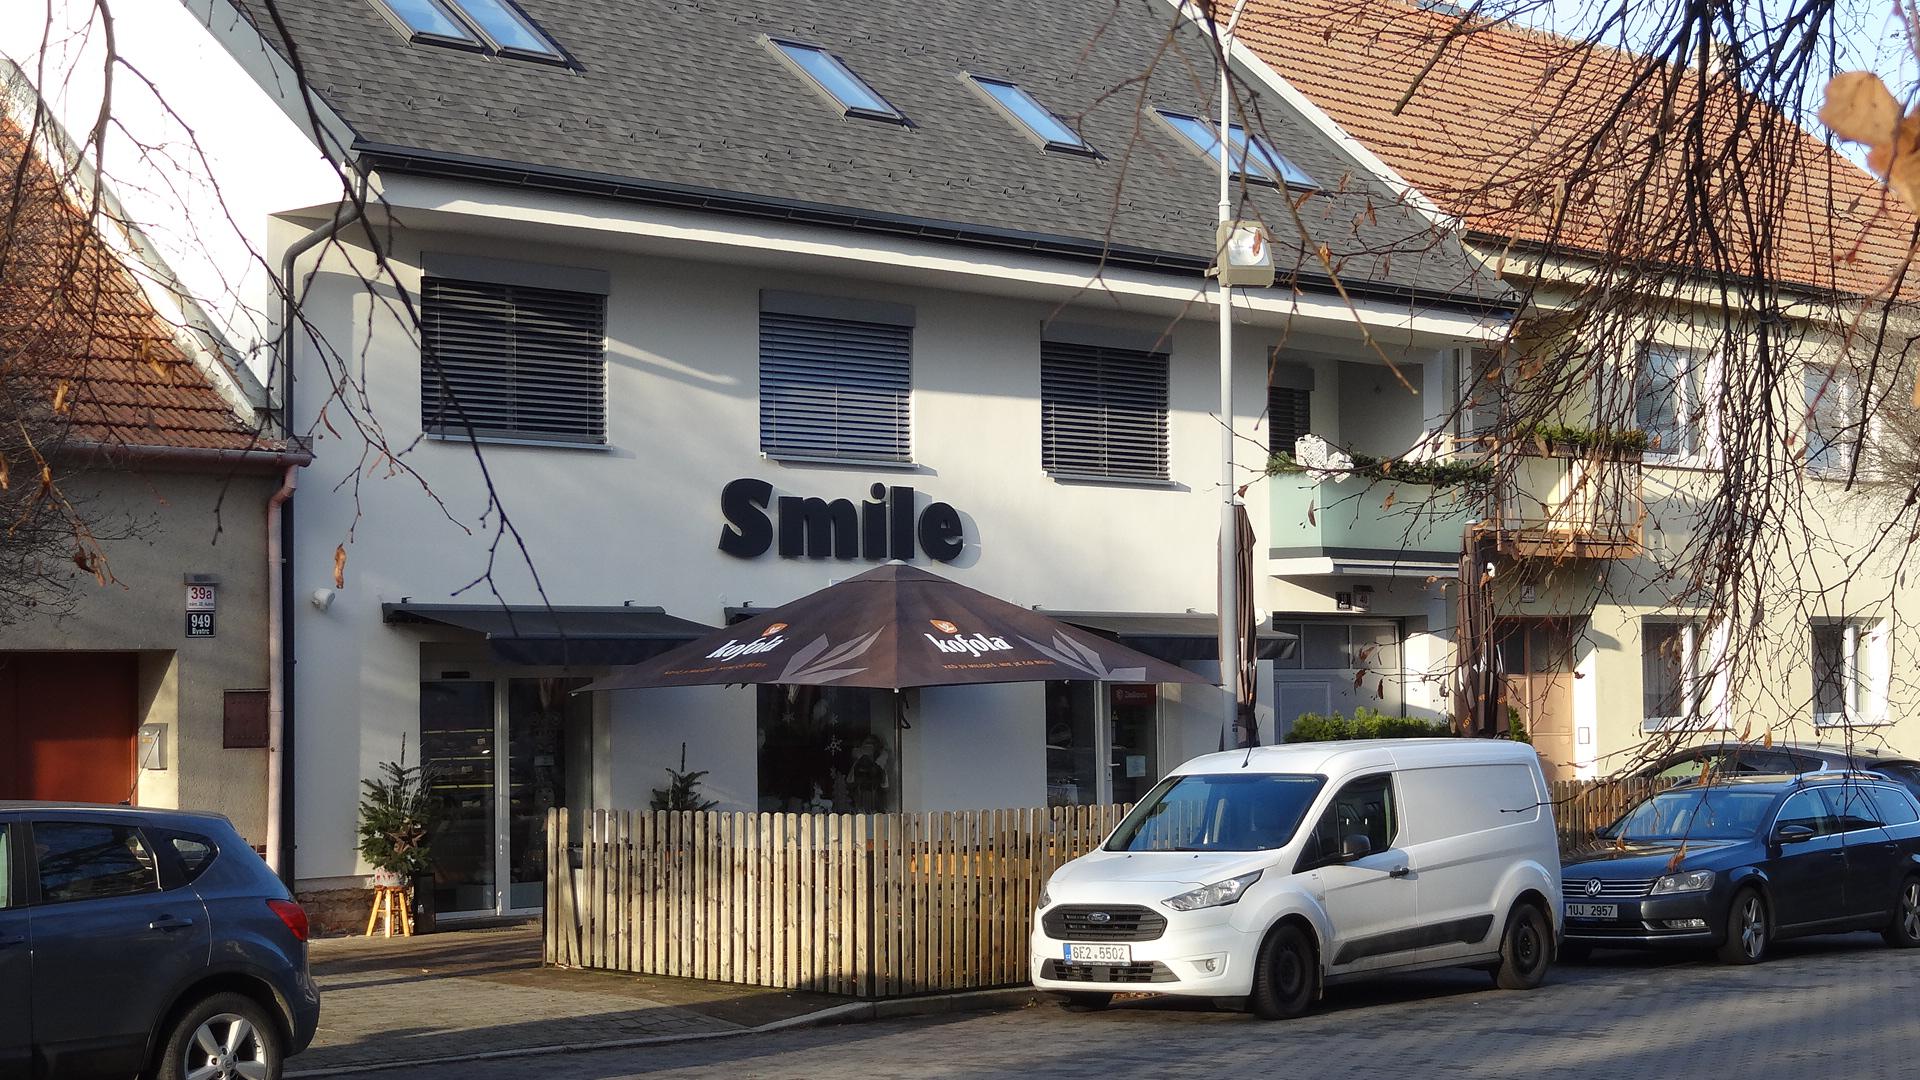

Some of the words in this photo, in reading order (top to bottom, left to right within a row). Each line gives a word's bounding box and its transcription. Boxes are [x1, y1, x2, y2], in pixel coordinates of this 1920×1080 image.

[718, 478, 963, 562] Smile
[191, 587, 212, 600] 39a
[191, 614, 211, 628] 949
[705, 635, 784, 662] kofola
[924, 632, 1013, 657] kofola
[1568, 905, 1584, 916] 1UJ
[1590, 905, 1613, 916] 2957
[1099, 947, 1124, 960] 5502
